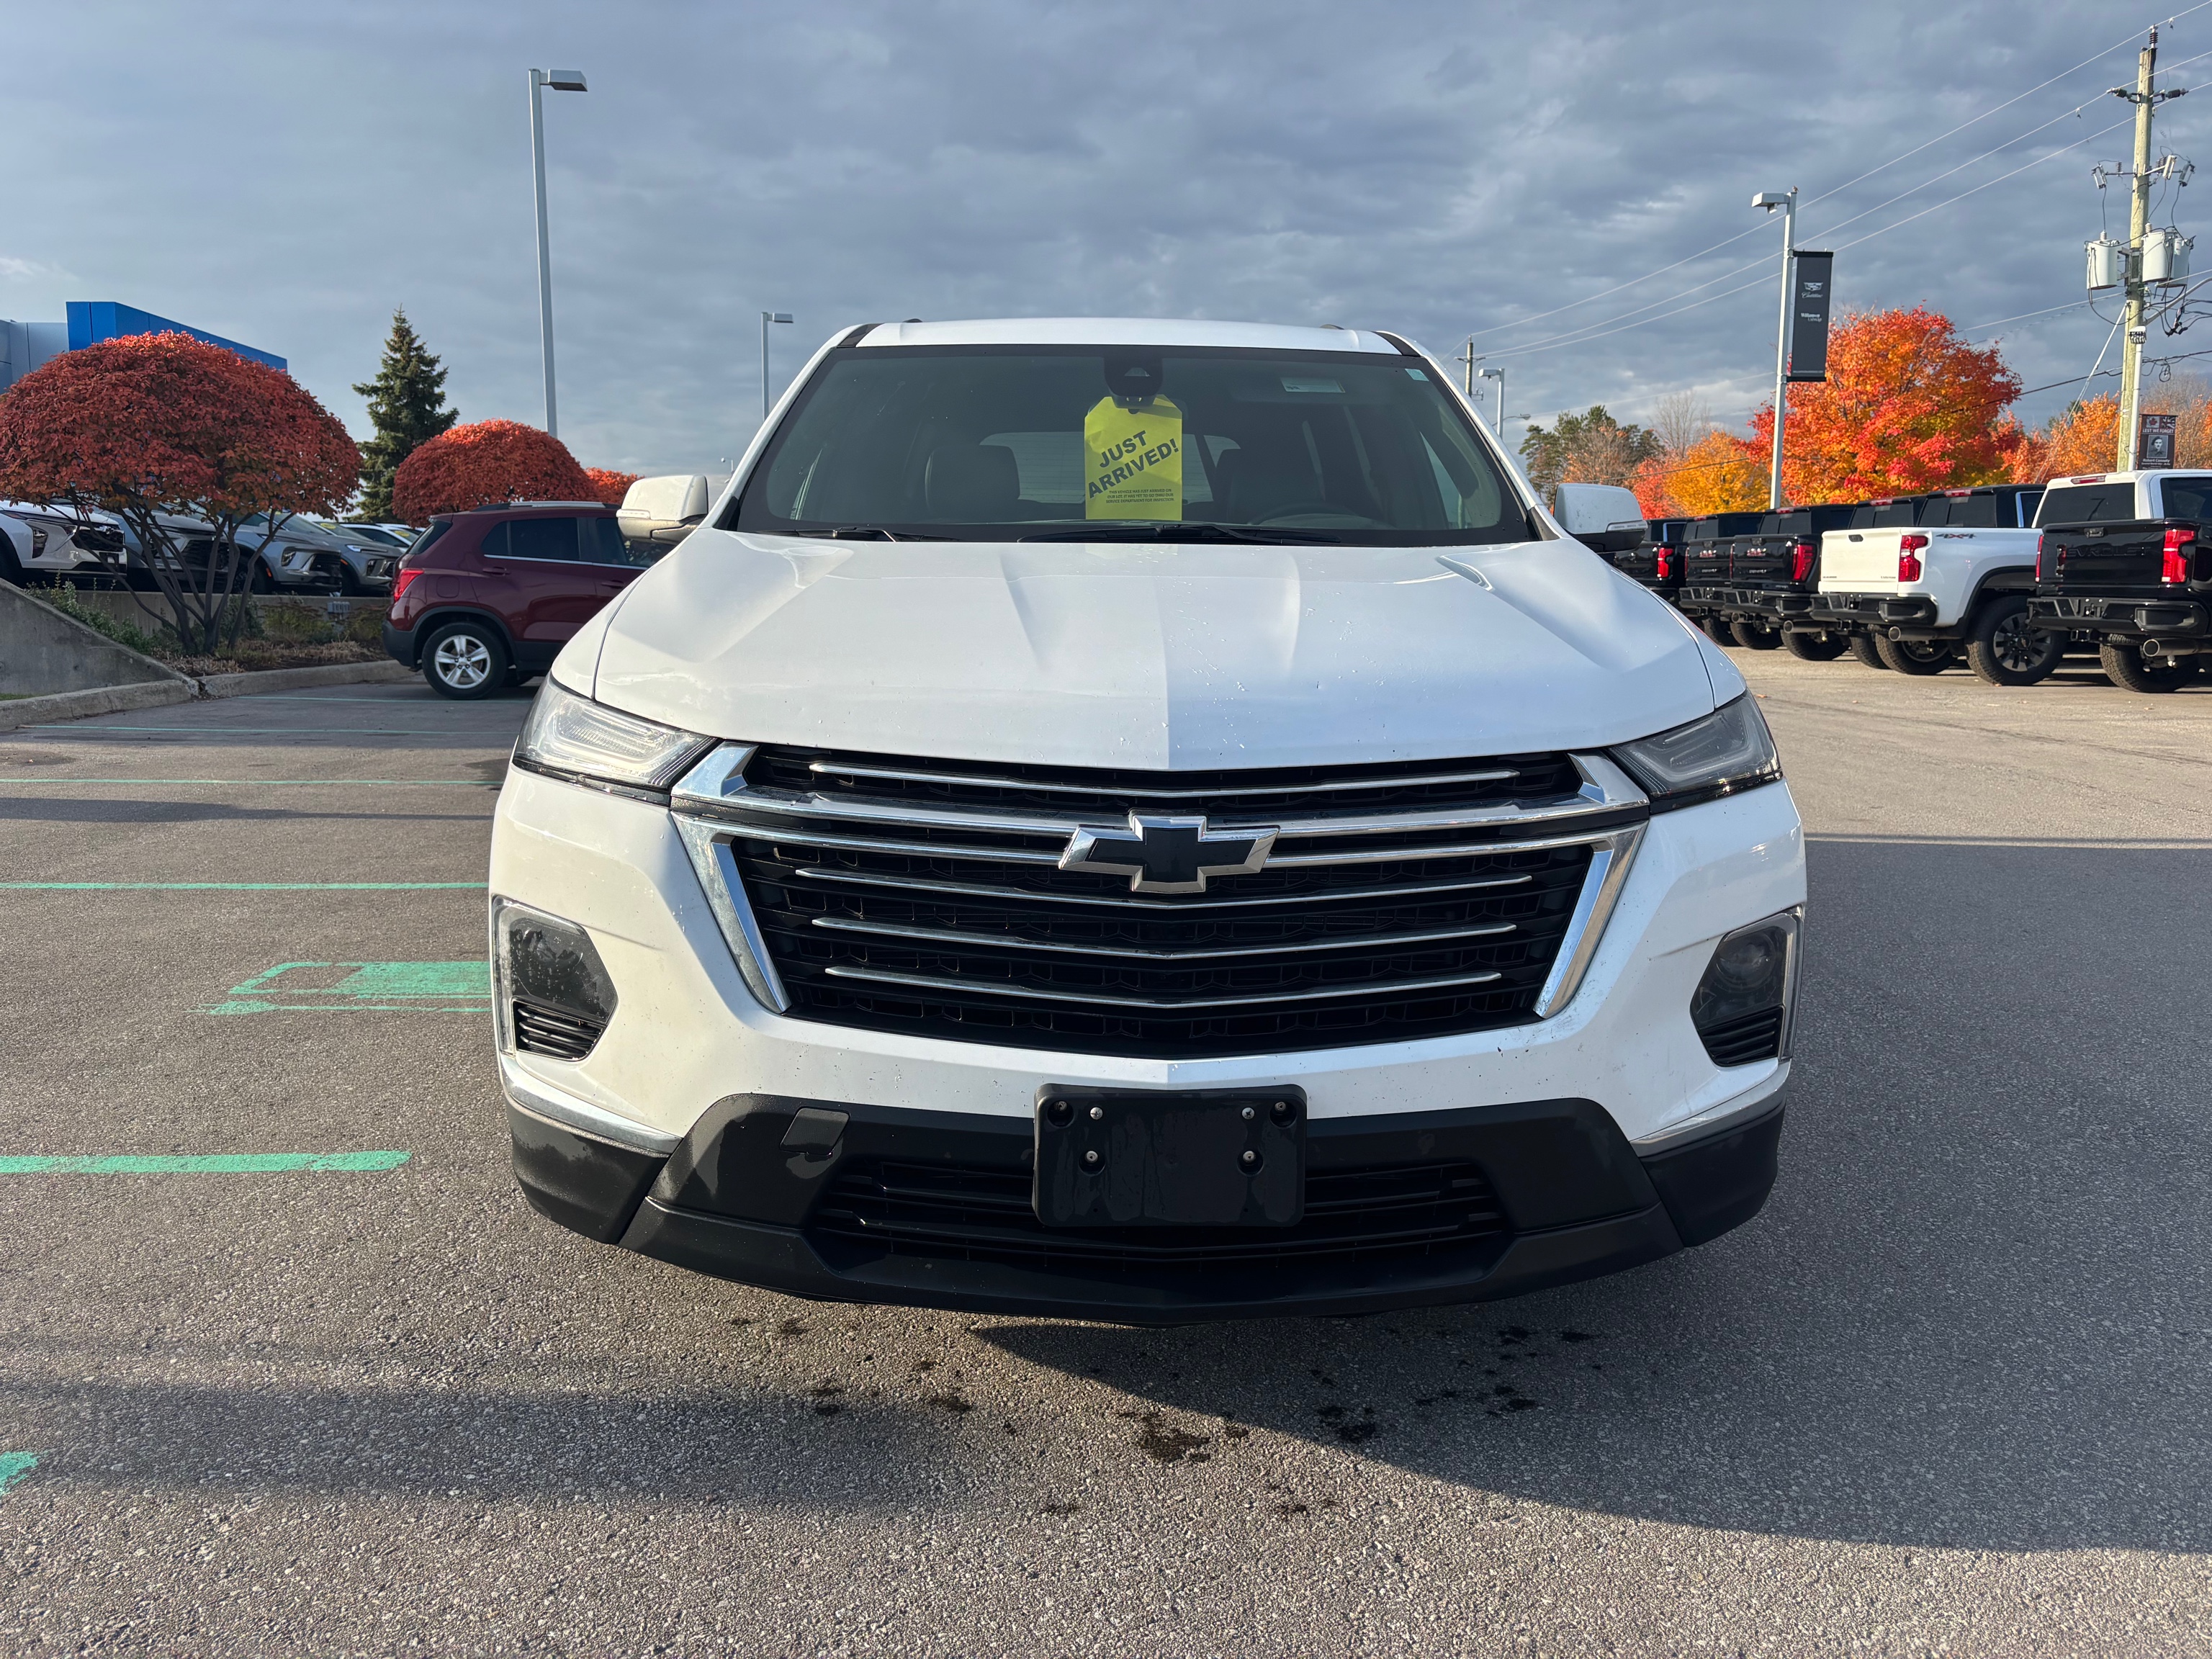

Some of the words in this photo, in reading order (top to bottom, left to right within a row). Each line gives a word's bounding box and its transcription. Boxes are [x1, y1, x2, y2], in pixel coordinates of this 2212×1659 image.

[1100, 430, 1146, 468] JUST
[1088, 438, 1179, 499] ARRIVED!
[2047, 547, 2152, 557] EVROLET
